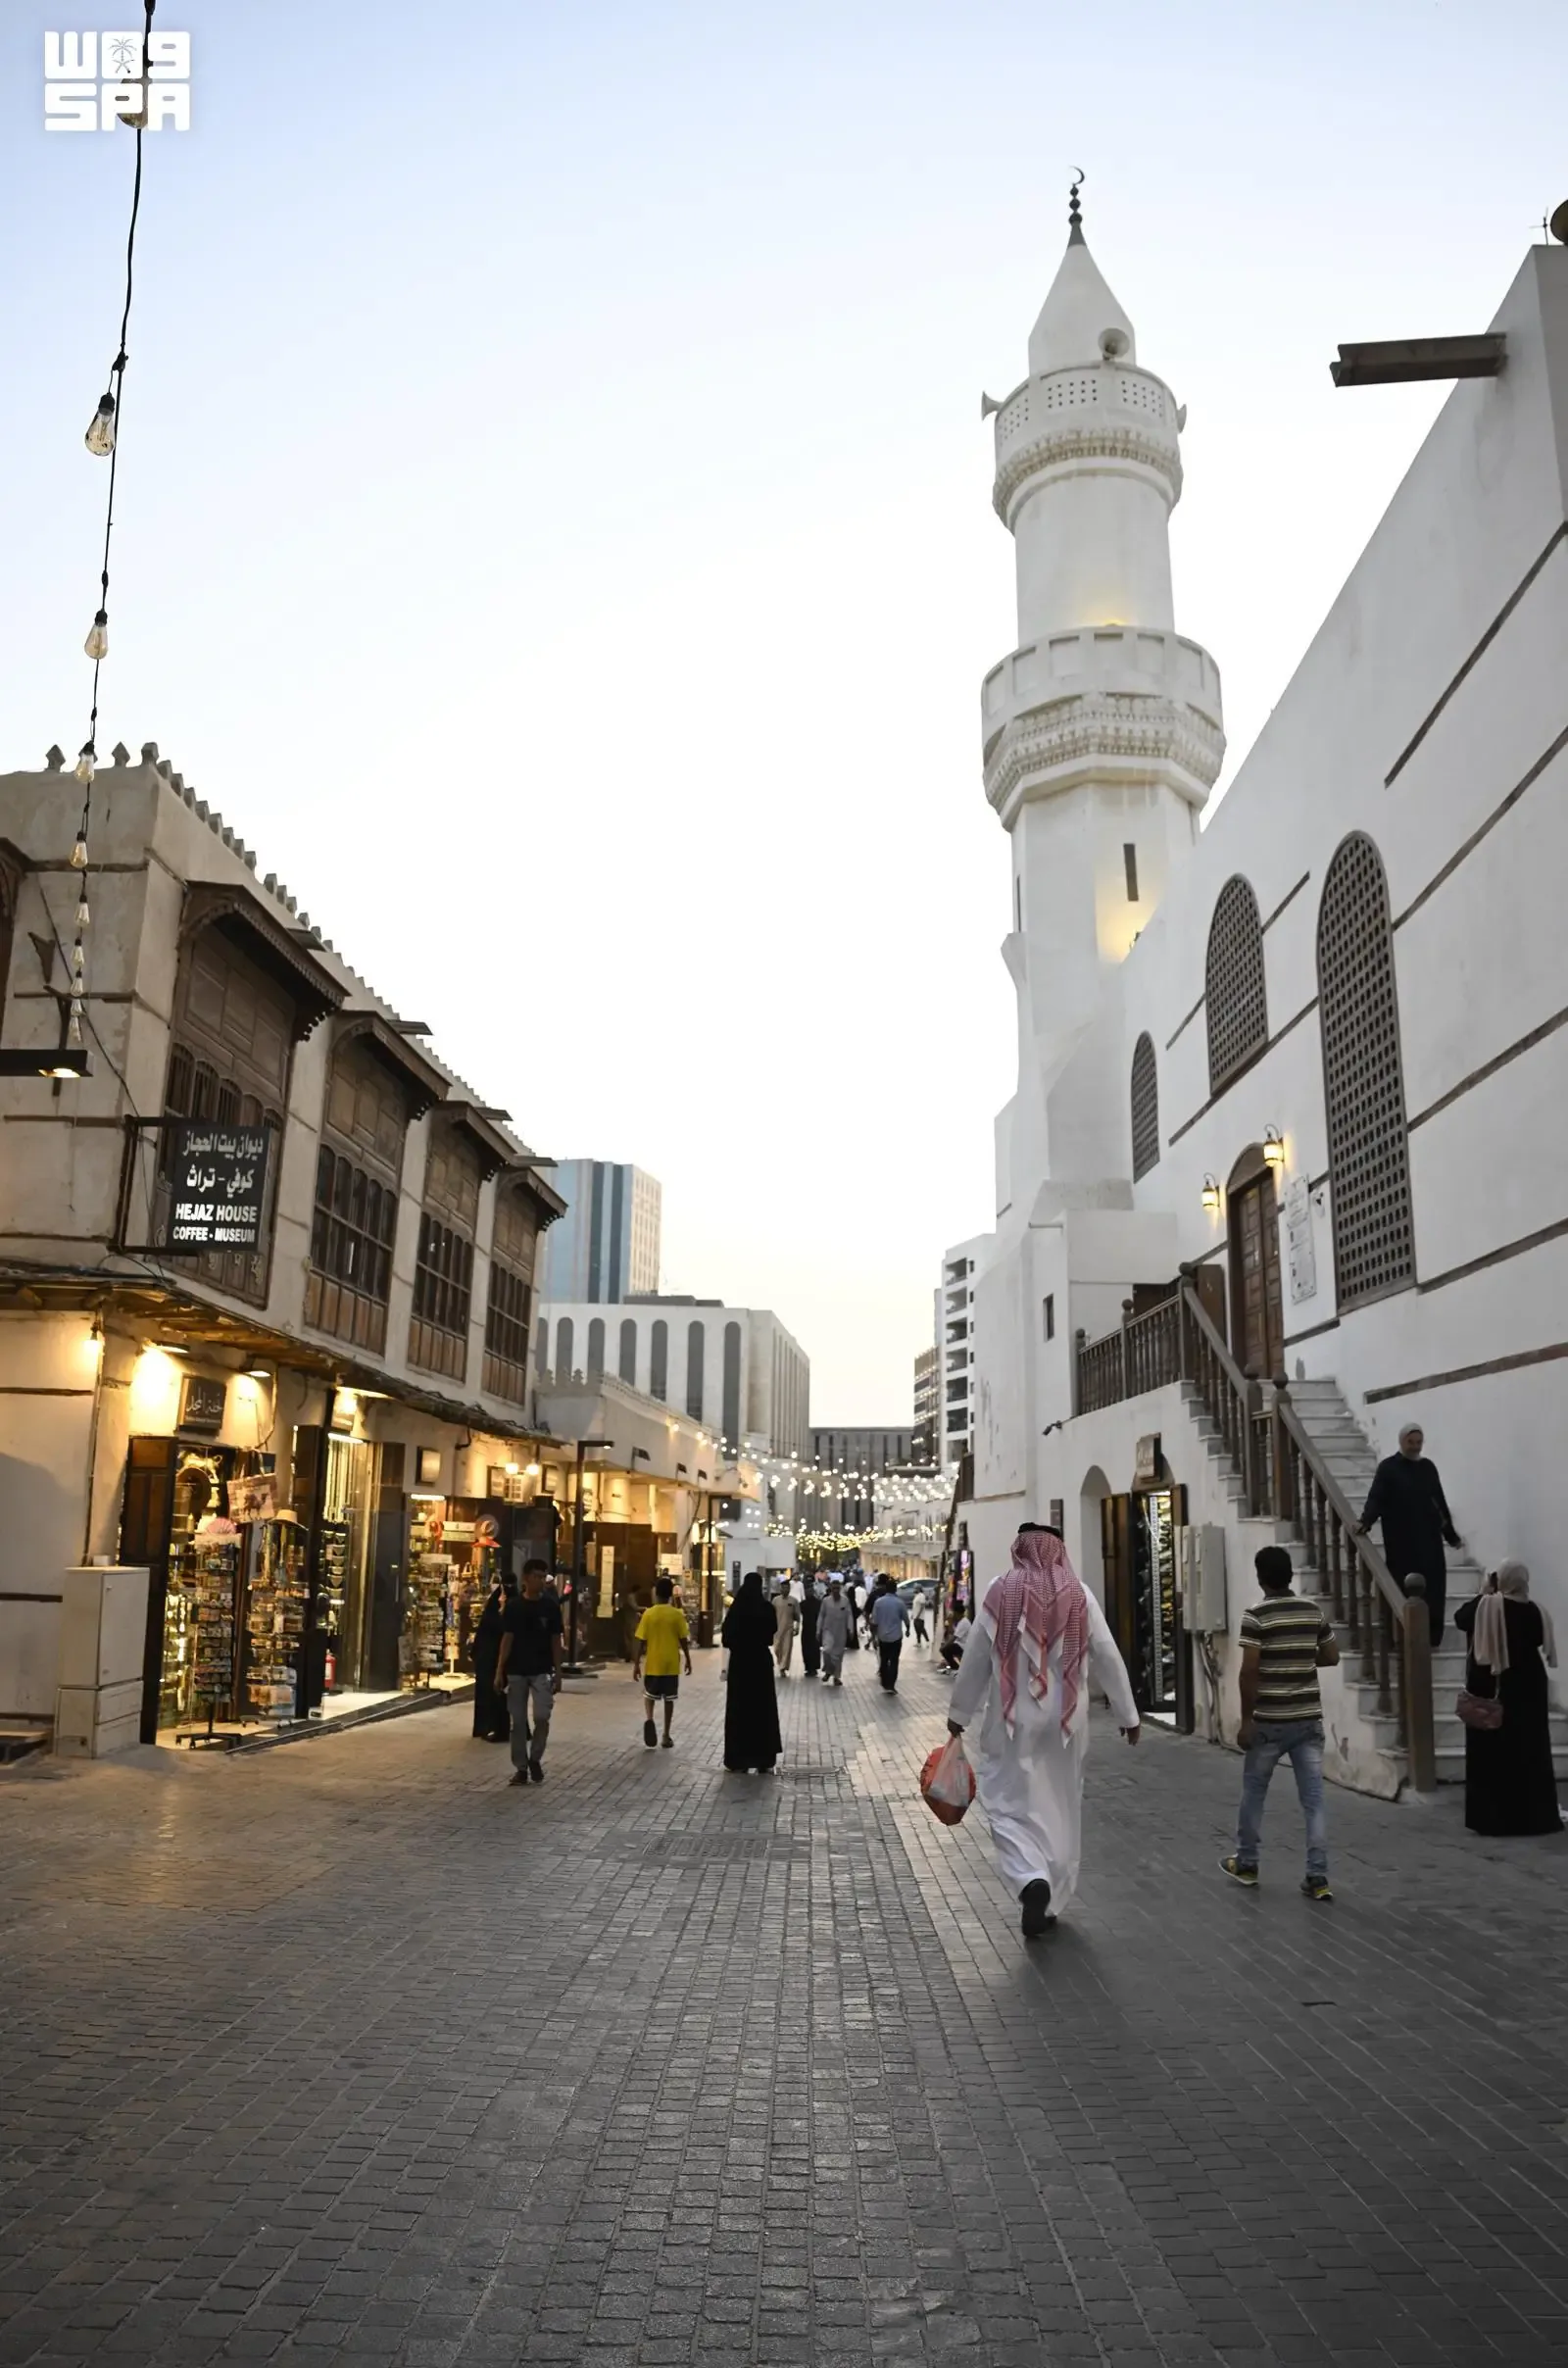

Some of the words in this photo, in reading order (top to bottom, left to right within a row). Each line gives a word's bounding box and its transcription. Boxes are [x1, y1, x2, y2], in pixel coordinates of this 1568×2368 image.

[182, 1130, 218, 1157] الحجاز
[218, 1134, 236, 1160] بيت
[236, 1134, 264, 1160] ديوان
[186, 1163, 216, 1193] تراث
[226, 1167, 254, 1199] كوفي
[175, 1203, 215, 1221] HEJAZ
[216, 1205, 258, 1223] HOUSE
[172, 1225, 209, 1241] COFFEE
[215, 1227, 255, 1243] MUSEUM
